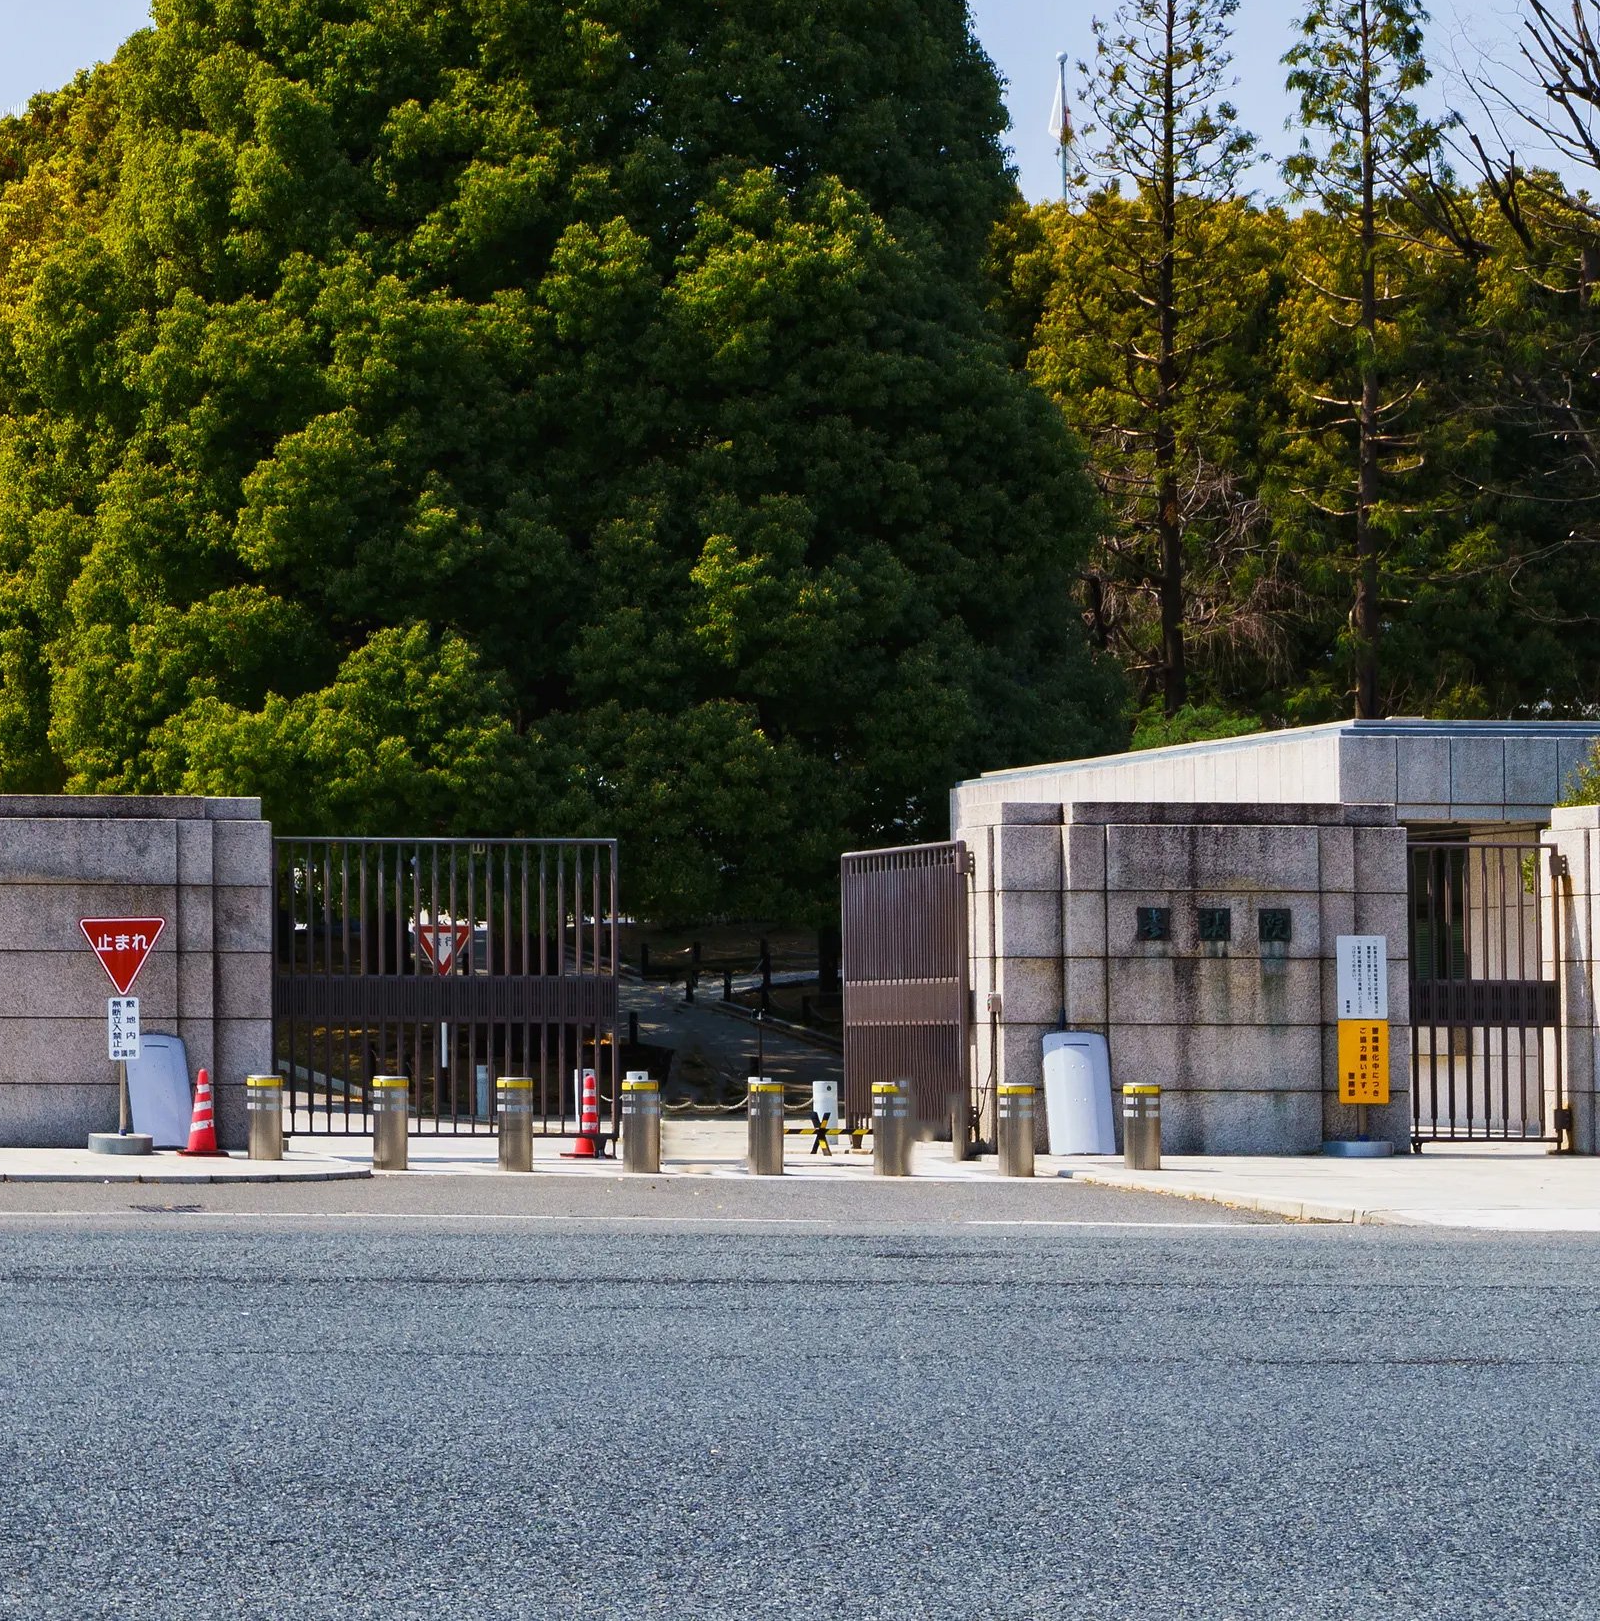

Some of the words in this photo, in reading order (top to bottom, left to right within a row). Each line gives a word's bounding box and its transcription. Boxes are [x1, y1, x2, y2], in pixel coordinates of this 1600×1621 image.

[97, 933, 148, 951] 止まれ
[112, 1000, 122, 1048] 無断立入禁止
[125, 1000, 136, 1040] 敷地内
[113, 1049, 136, 1058] 参議院
